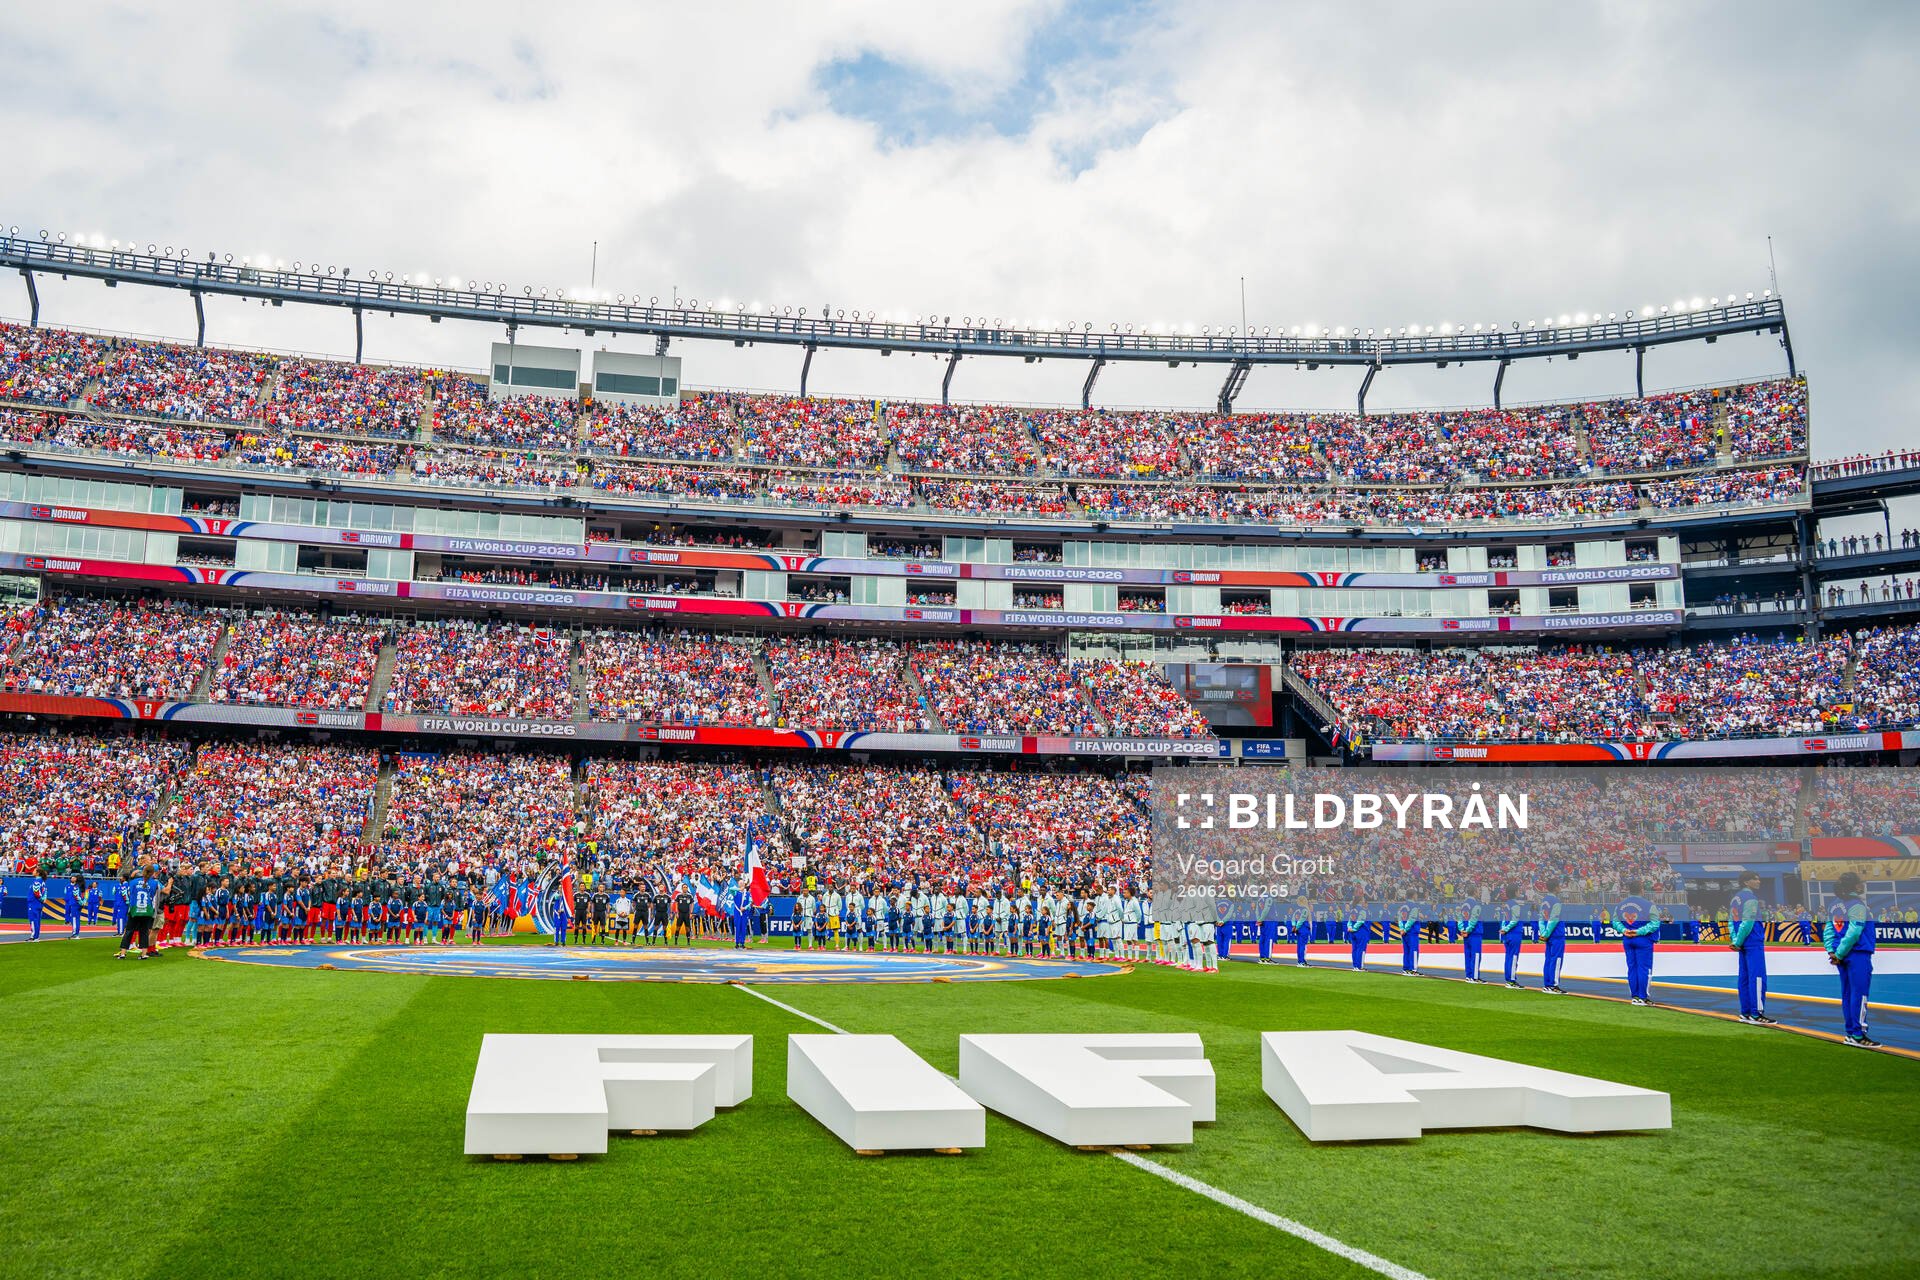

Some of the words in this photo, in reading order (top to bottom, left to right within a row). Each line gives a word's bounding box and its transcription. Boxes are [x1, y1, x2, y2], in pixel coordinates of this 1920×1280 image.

[51, 509, 87, 520] NORWAY
[360, 534, 392, 544] NORWAY
[450, 540, 472, 550] FIFA
[474, 542, 513, 552] WORLD
[515, 544, 536, 553] CUP
[538, 546, 576, 556] 2026
[648, 552, 678, 562] NORWAY
[45, 560, 81, 570] NORWAY
[922, 565, 952, 574] NORWAY
[1088, 571, 1122, 579] 2026
[1190, 573, 1220, 582] NORWAY
[1456, 575, 1487, 584] NORWAY
[1542, 573, 1565, 582] FIFA
[1566, 571, 1605, 581] WORLD
[1607, 569, 1630, 578] CUP
[1631, 567, 1670, 576] 2026
[356, 582, 389, 592] NORWAY
[446, 588, 469, 598] FIFA
[471, 590, 510, 600] WORLD
[512, 592, 534, 601] CUP
[535, 594, 573, 603] 2026
[646, 599, 677, 609] NORWAY
[922, 610, 952, 620] NORWAY
[1005, 614, 1026, 622] FIFA
[1066, 616, 1086, 624] CUP
[1088, 616, 1124, 624] 2026
[1545, 618, 1568, 627] FIFA
[1570, 616, 1609, 626] WORLD
[1611, 615, 1633, 624] CUP
[1634, 613, 1674, 622] 2026
[1192, 618, 1221, 627] NORWAY
[1459, 620, 1490, 629] NORWAY
[1204, 690, 1233, 700] NORWAY
[318, 714, 358, 726] NORWAY
[423, 719, 451, 730] FIFA
[452, 721, 501, 732] WORLD
[502, 722, 528, 733] CUP
[530, 725, 576, 735] 2026
[658, 729, 695, 740] NORWAY
[980, 739, 1016, 749] NORWAY
[1075, 742, 1101, 751] FIFA
[1102, 742, 1145, 752] WORLD
[1147, 743, 1171, 752] CUP
[1172, 744, 1214, 753] 2026
[1827, 737, 1868, 749] NORWAY
[1453, 748, 1487, 758] NORWAY
[1875, 928, 1903, 938] FIFA
[464, 1030, 1671, 1156] FIFA
